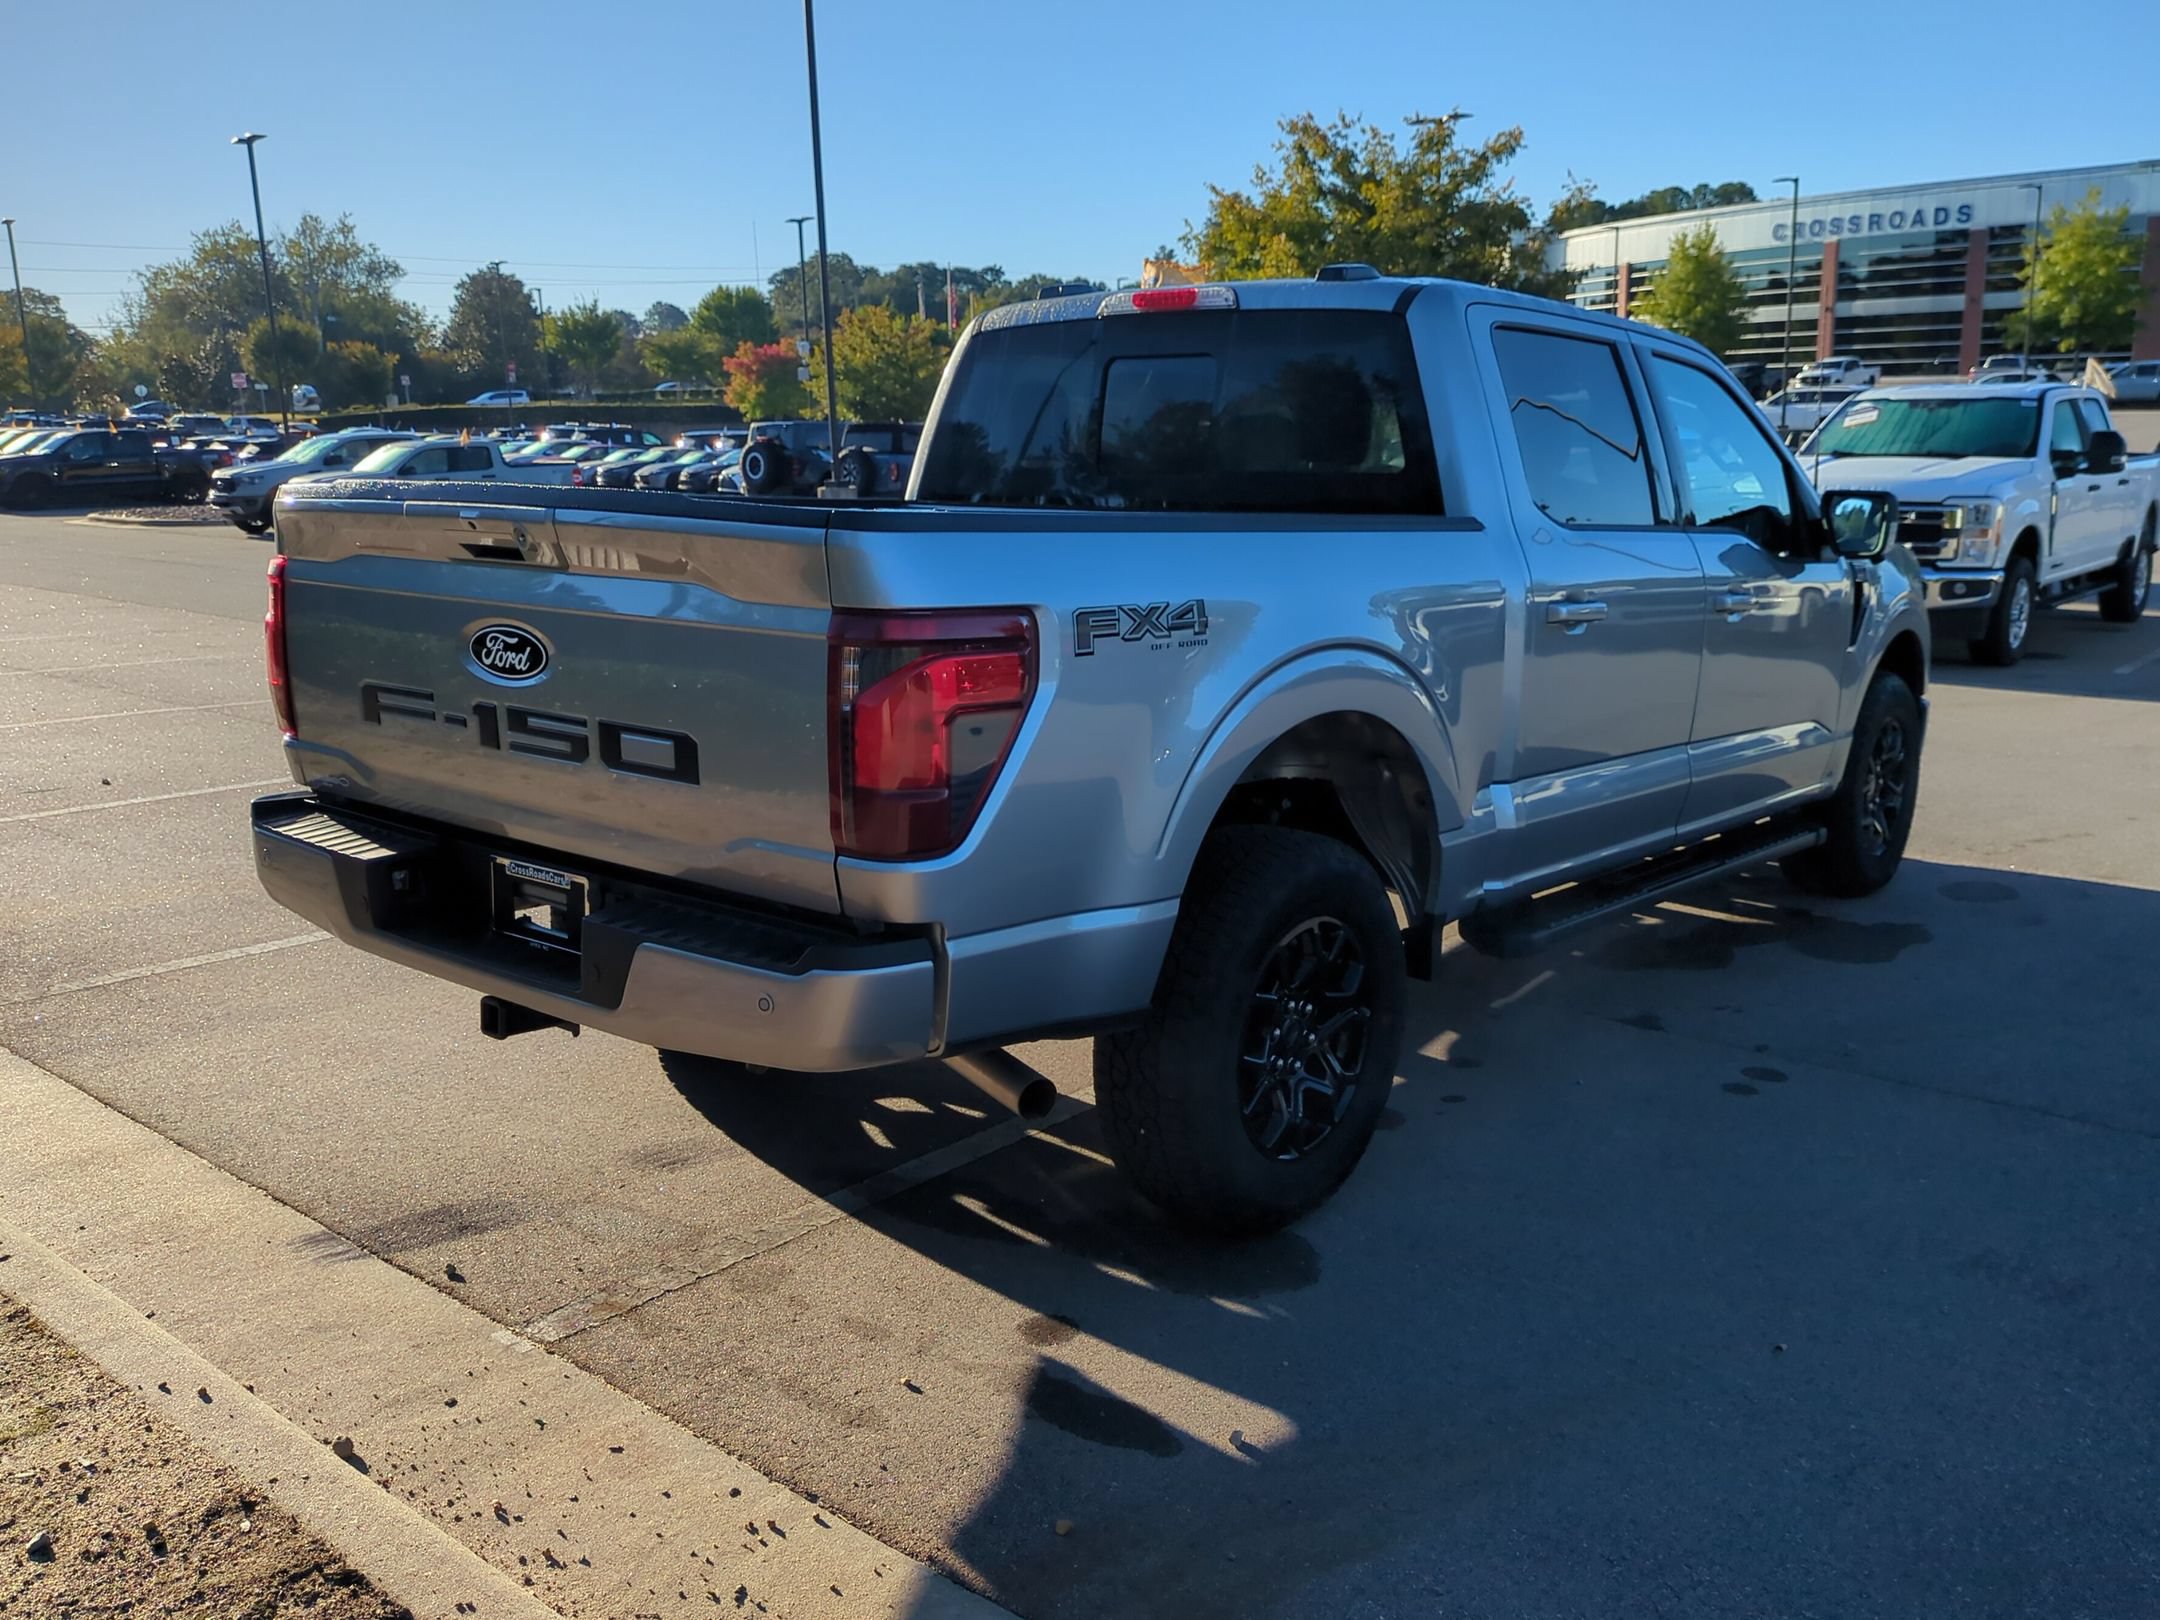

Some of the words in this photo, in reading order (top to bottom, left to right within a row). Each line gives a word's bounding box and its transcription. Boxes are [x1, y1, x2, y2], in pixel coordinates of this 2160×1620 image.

[1772, 204, 1974, 242] CROSSROADS
[1072, 598, 1209, 657] FX4
[1150, 642, 1171, 651] OFF
[1178, 638, 1208, 648] ROAD
[481, 632, 532, 672] Ford
[361, 680, 700, 786] F-150
